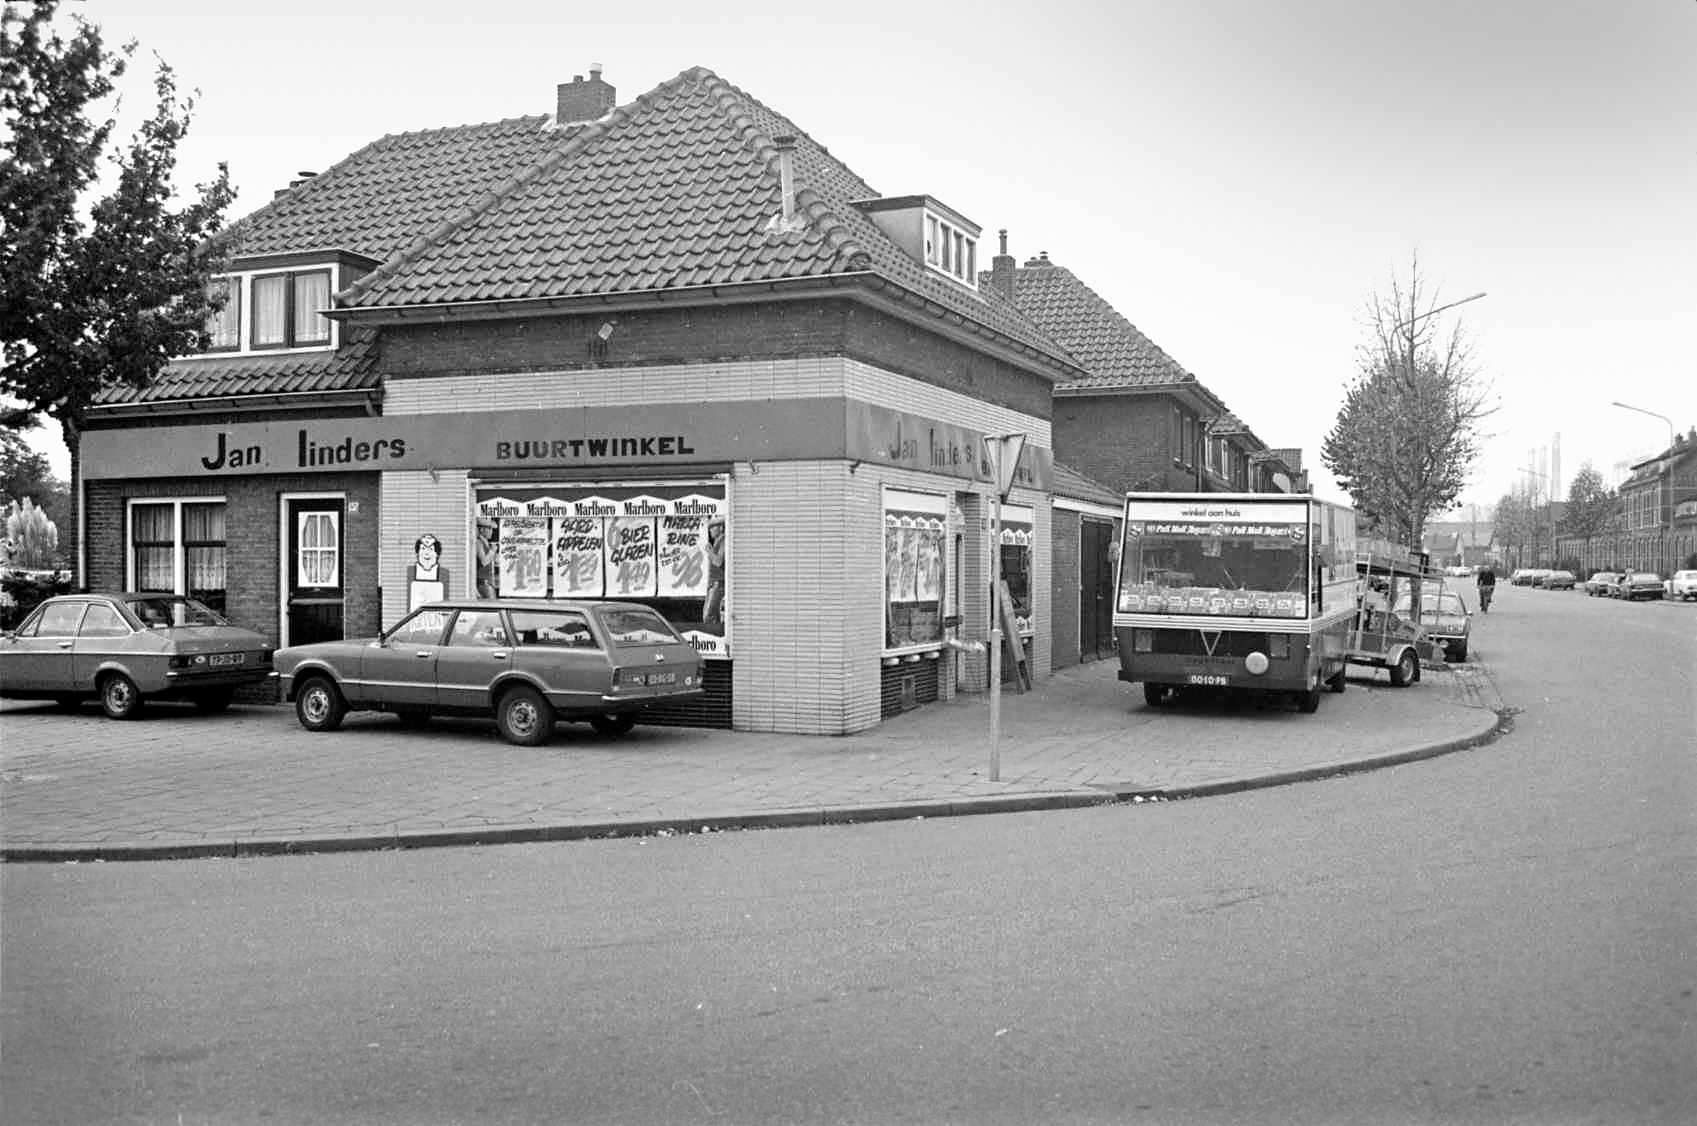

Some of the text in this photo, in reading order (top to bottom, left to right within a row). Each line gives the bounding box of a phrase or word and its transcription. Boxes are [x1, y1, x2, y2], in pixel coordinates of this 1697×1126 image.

[201, 429, 405, 469] Jan linders
[480, 501, 519, 516] Marlboro
[527, 501, 567, 516] Marlboro
[575, 501, 616, 516] Marlboro
[624, 500, 666, 515] Marlboro
[674, 499, 717, 514] Marlboro
[620, 525, 650, 545] BIER
[610, 541, 654, 566] GLAZEN
[688, 635, 717, 652] lboro
